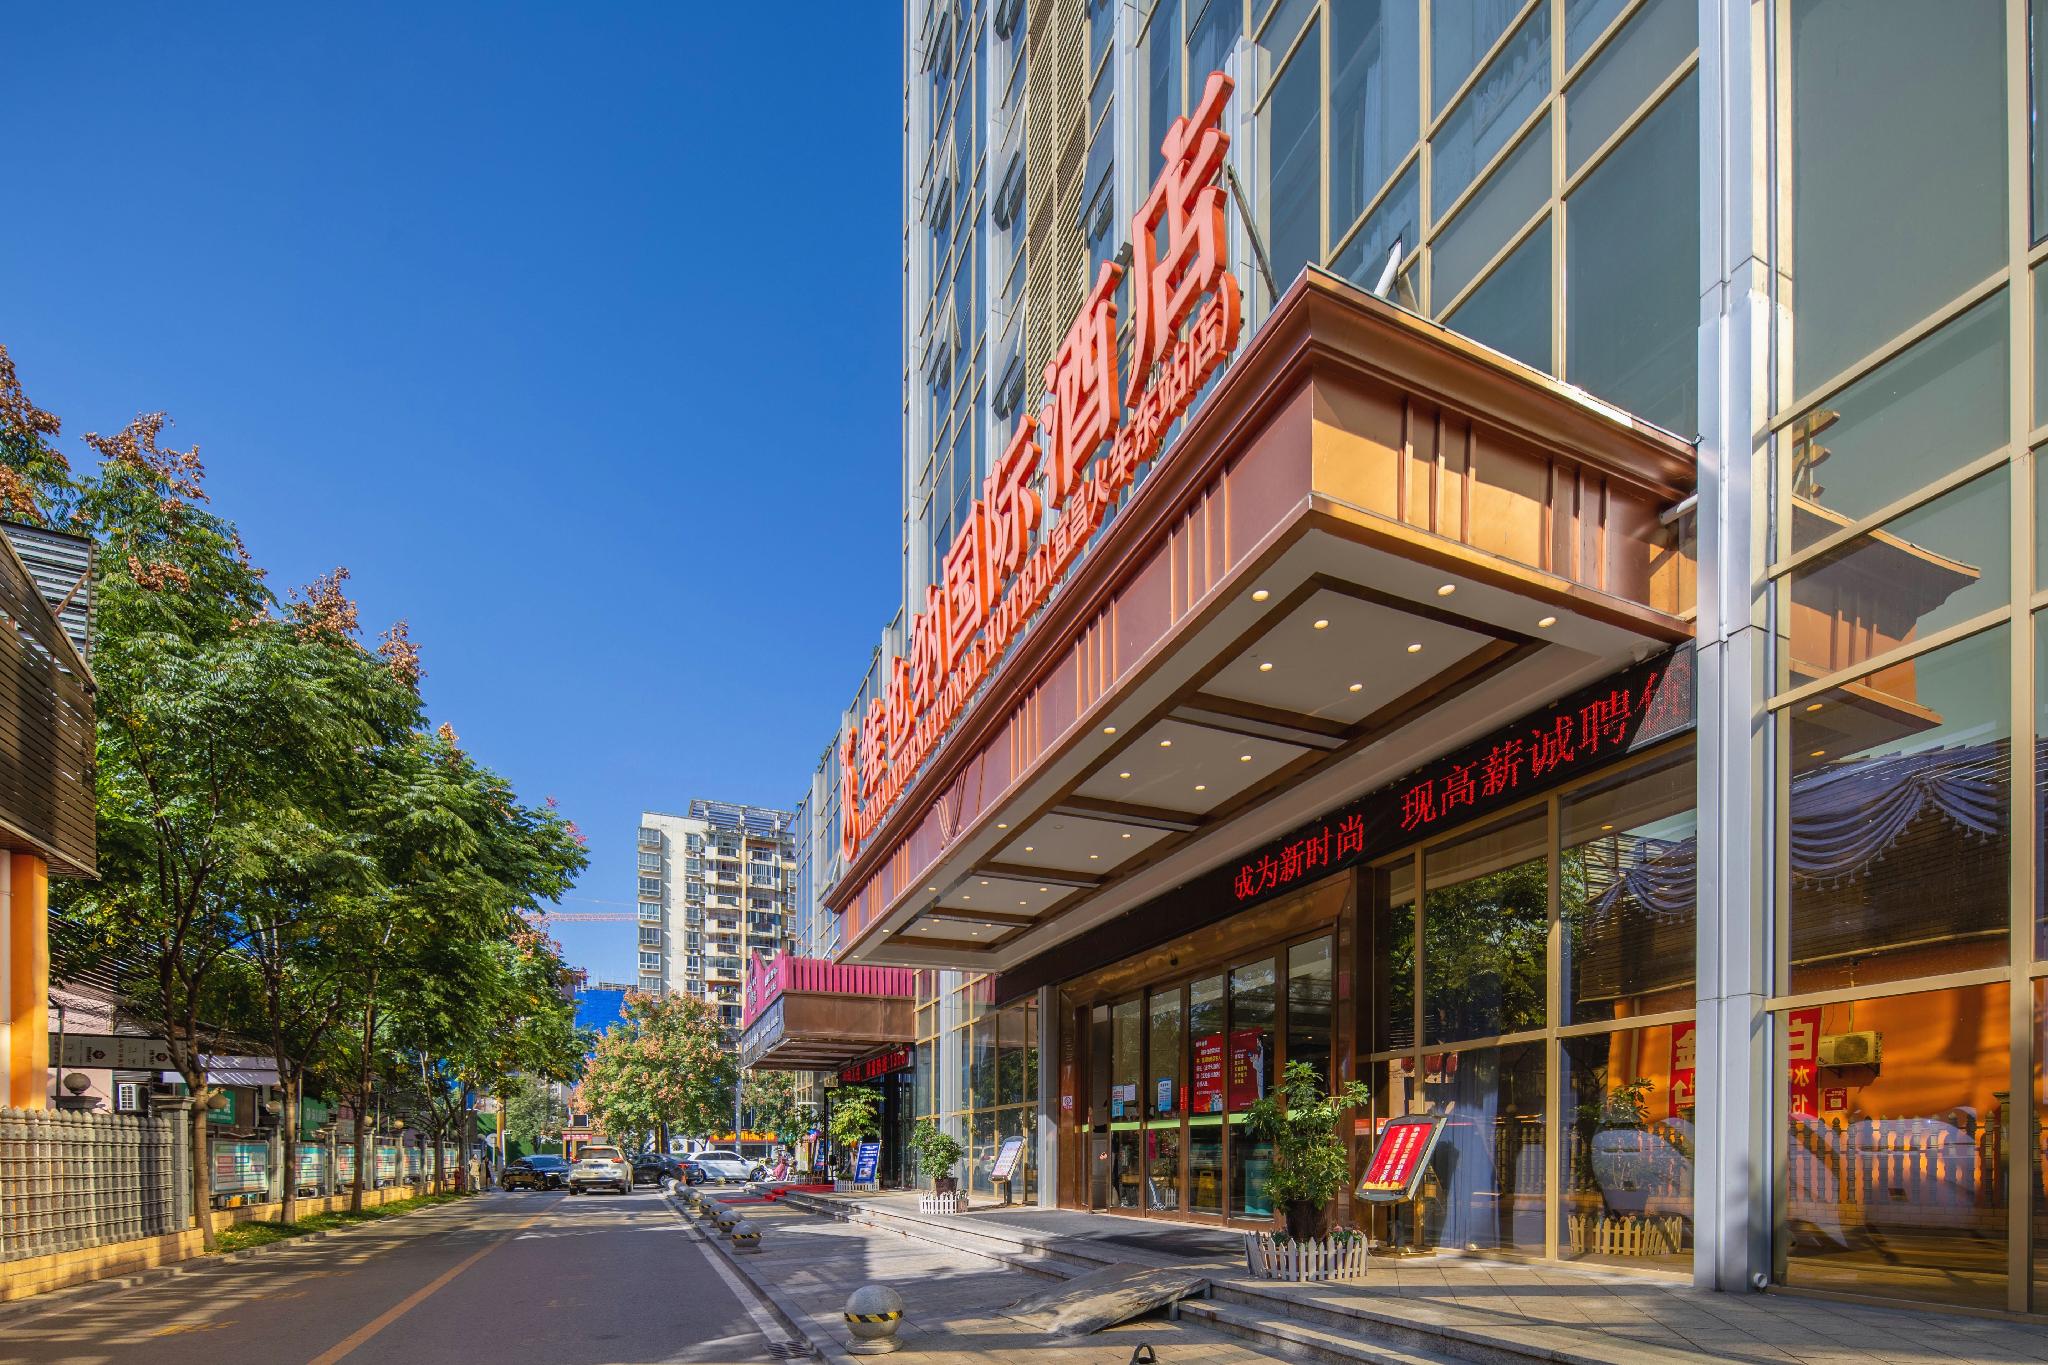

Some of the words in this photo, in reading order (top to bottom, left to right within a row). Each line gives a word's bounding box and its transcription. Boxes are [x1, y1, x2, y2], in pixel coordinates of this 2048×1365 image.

[861, 71, 1236, 799] 维也纳国际酒店
[860, 779, 888, 840] VIENNA
[887, 639, 988, 801] INTERNATIONAL
[1234, 813, 1364, 901] 成为新时尚
